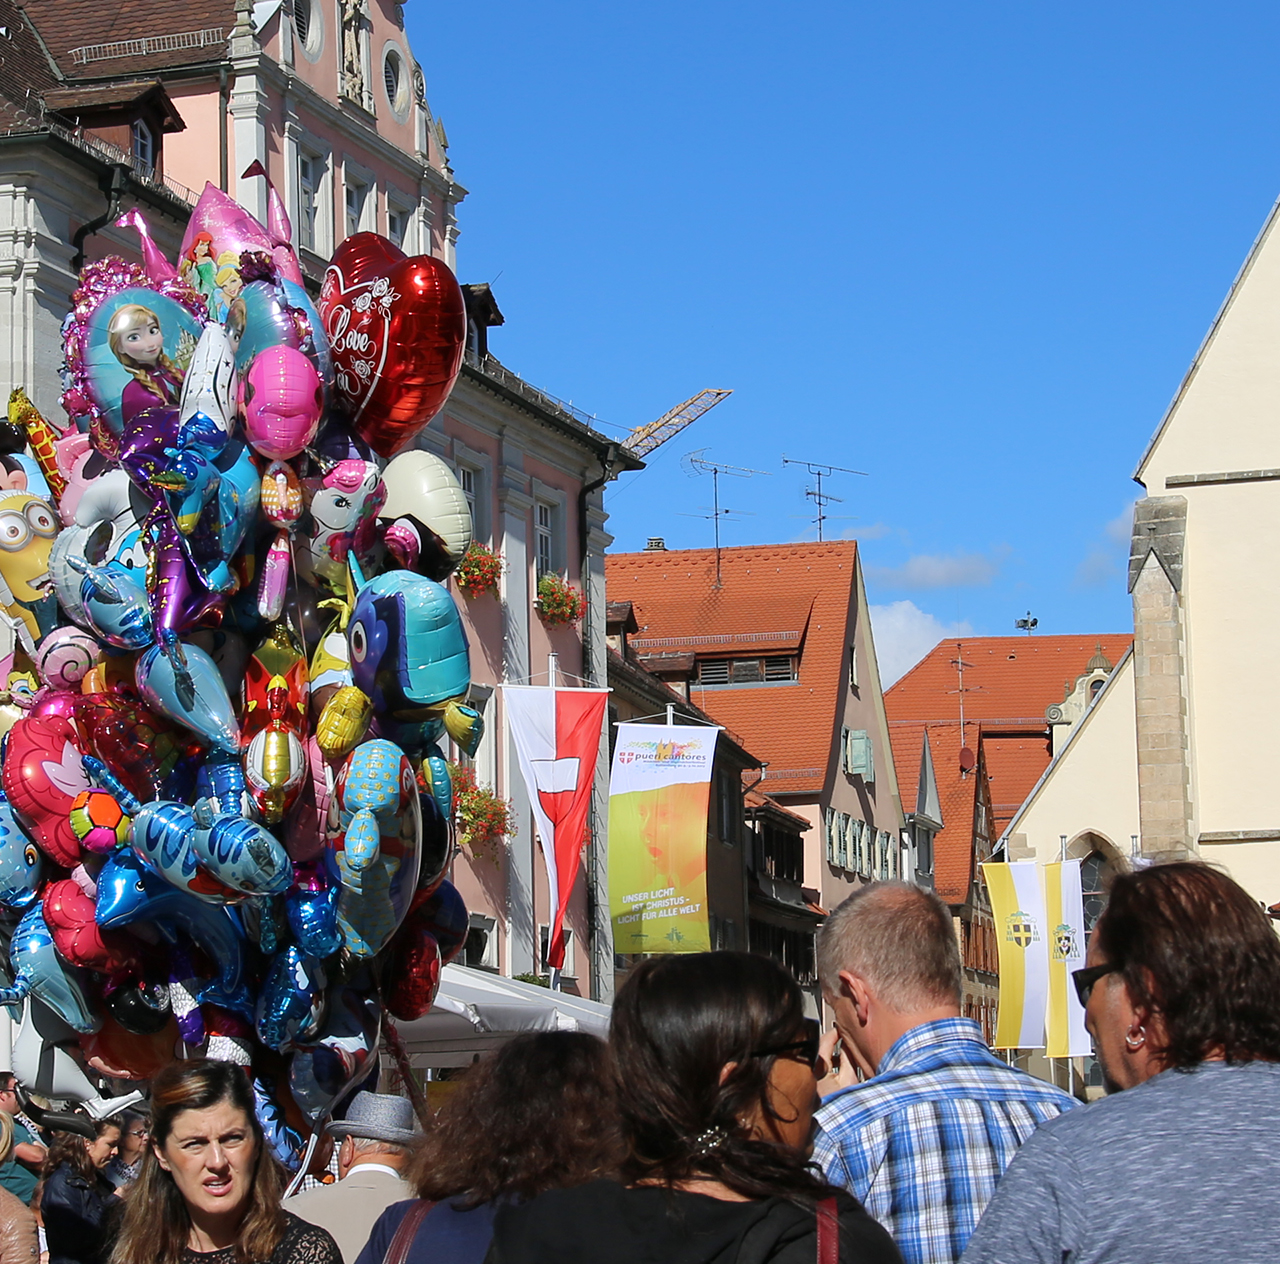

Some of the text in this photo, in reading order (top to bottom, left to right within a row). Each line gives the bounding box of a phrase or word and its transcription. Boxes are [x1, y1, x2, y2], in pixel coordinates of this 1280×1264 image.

[328, 305, 376, 359] Love
[664, 753, 707, 761] cantores
[622, 887, 675, 903] UNSER LICHT
[631, 904, 644, 912] IST
[646, 896, 684, 910] CHRISTUS
[617, 904, 701, 925] LICHT FÜR ALLE WELT
